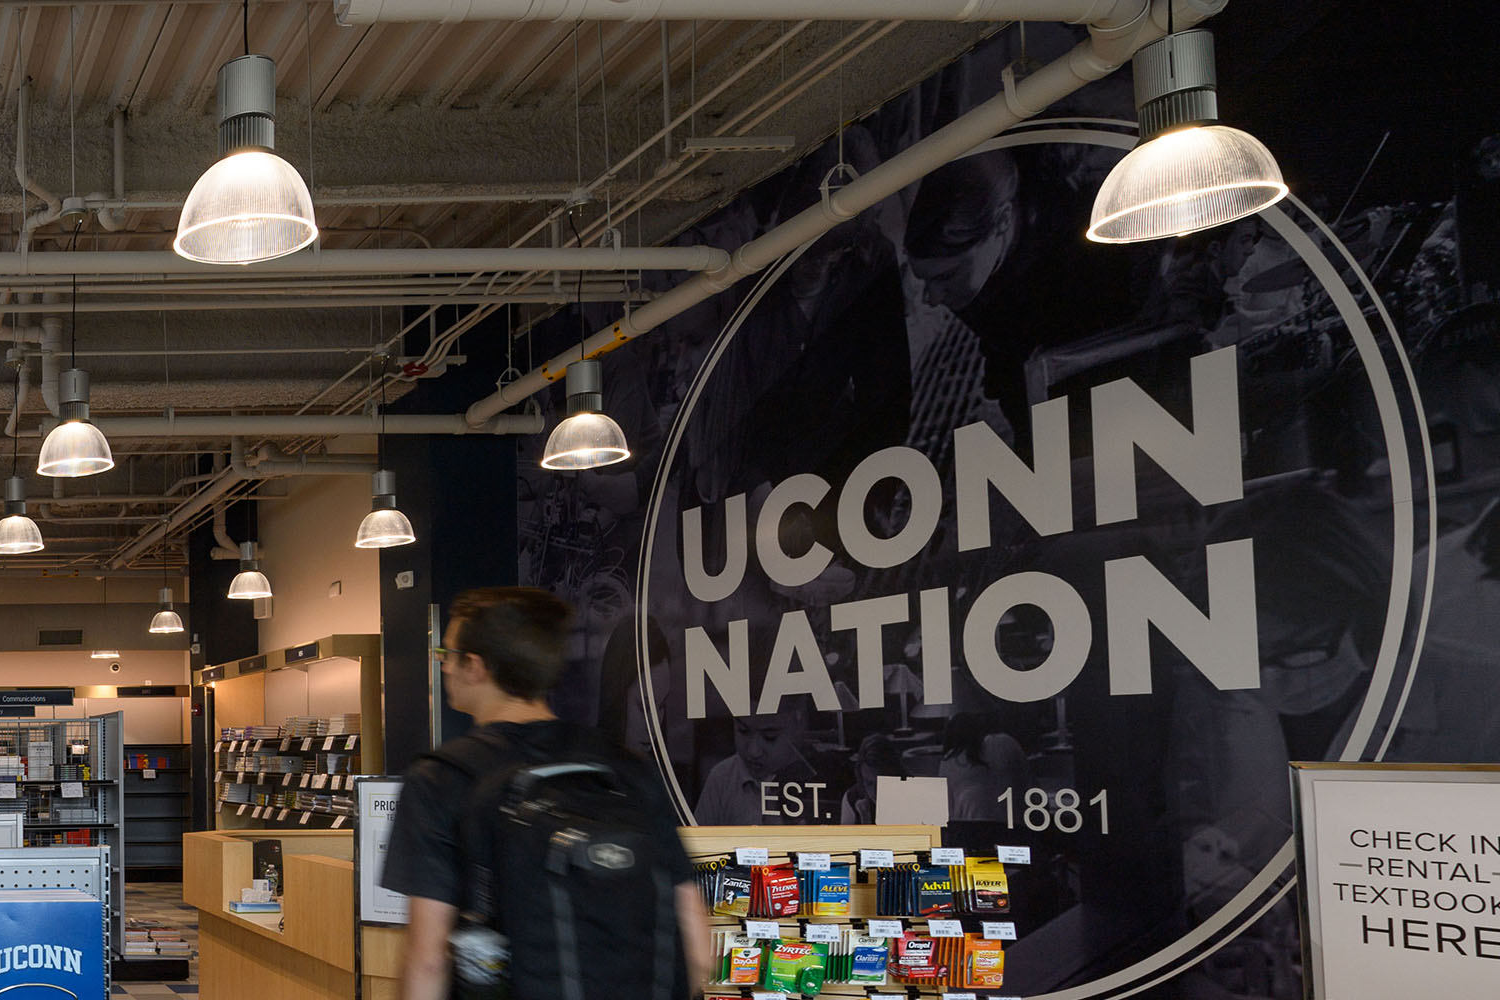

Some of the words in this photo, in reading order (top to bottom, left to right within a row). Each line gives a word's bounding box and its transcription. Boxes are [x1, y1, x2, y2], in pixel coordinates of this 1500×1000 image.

[682, 344, 1244, 602] UCONN
[685, 537, 1261, 720] NATION
[2, 695, 46, 703] Communications
[760, 781, 832, 819] EST.
[997, 786, 1109, 834] 1881
[1350, 829, 1458, 853] CHECK
[1471, 835, 1500, 855] IN
[1367, 857, 1491, 883] RENTAL
[921, 881, 950, 891] Advil
[774, 943, 812, 955] ZYRTEC
[908, 941, 931, 950] Orajel
[1362, 915, 1500, 960] HERE
[733, 958, 758, 966] DayQuil
[854, 954, 879, 963] Claritin
